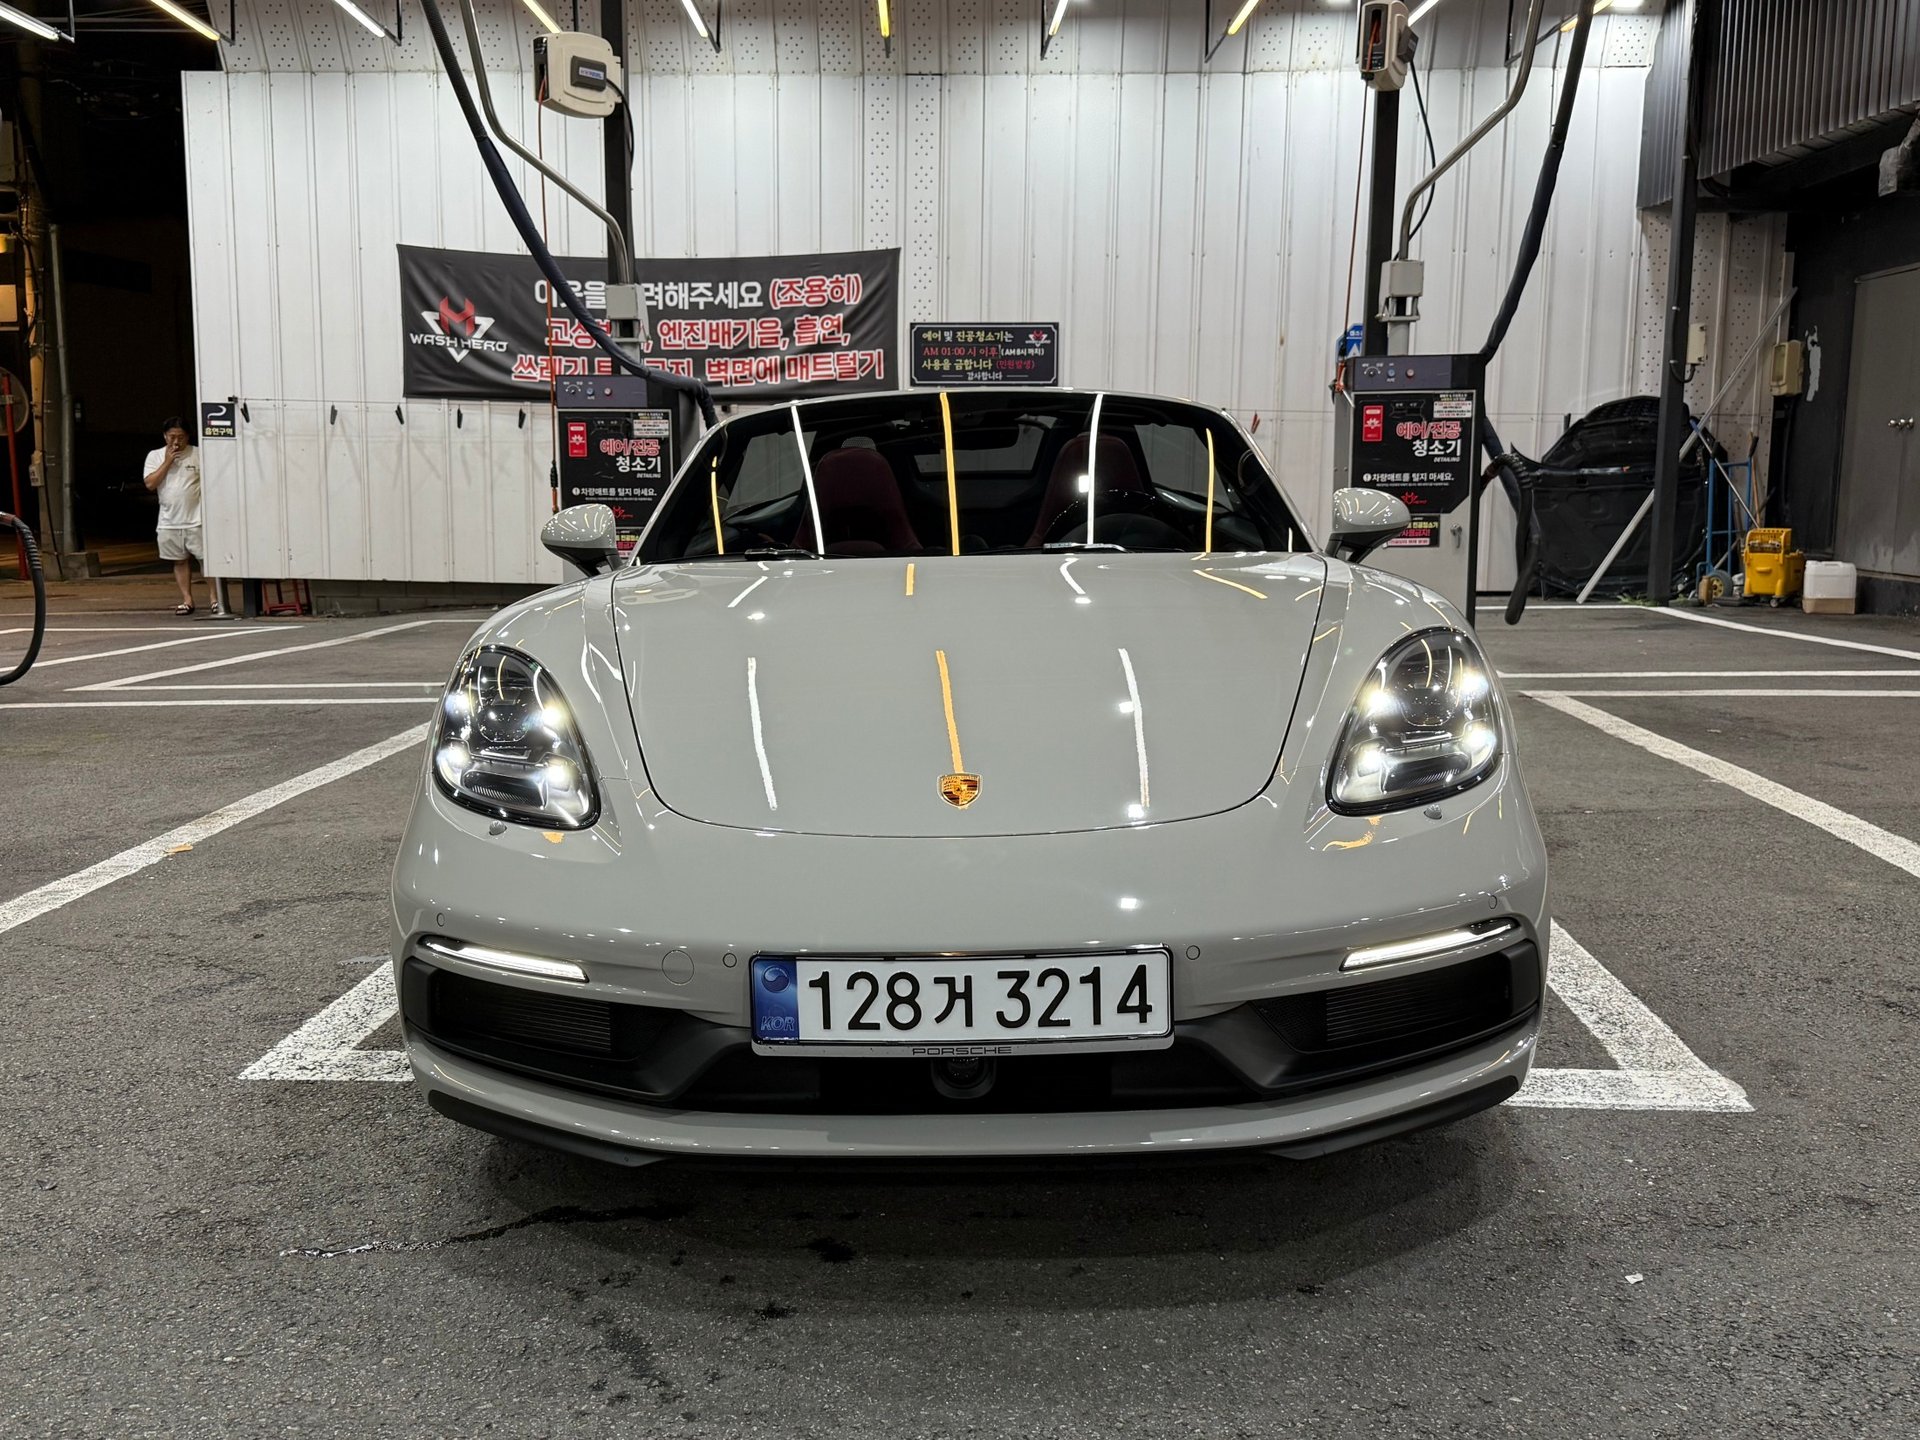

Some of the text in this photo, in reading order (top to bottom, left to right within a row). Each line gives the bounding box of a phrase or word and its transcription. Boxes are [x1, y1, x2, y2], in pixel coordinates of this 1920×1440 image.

[769, 274, 862, 310] (조용히)
[658, 318, 789, 350] 엔진배기음,
[794, 313, 851, 345] 흡연,
[922, 330, 942, 342] 에어
[955, 330, 1014, 342] 진공청소기는
[409, 333, 509, 352] WASH HERO
[922, 347, 939, 356] AM
[706, 356, 780, 387] 벽면에
[785, 349, 884, 382] 매트털기
[921, 359, 952, 371] 사용을
[954, 358, 992, 371] 금합니다
[1395, 421, 1461, 440] 에어/진공
[599, 438, 660, 456] 에어/진공
[1412, 440, 1461, 457] 청소기
[616, 456, 661, 473] 청소기
[808, 963, 1153, 1031] 128거 3214
[760, 1015, 796, 1032] KOR
[912, 1046, 1012, 1056] PORSCHE
